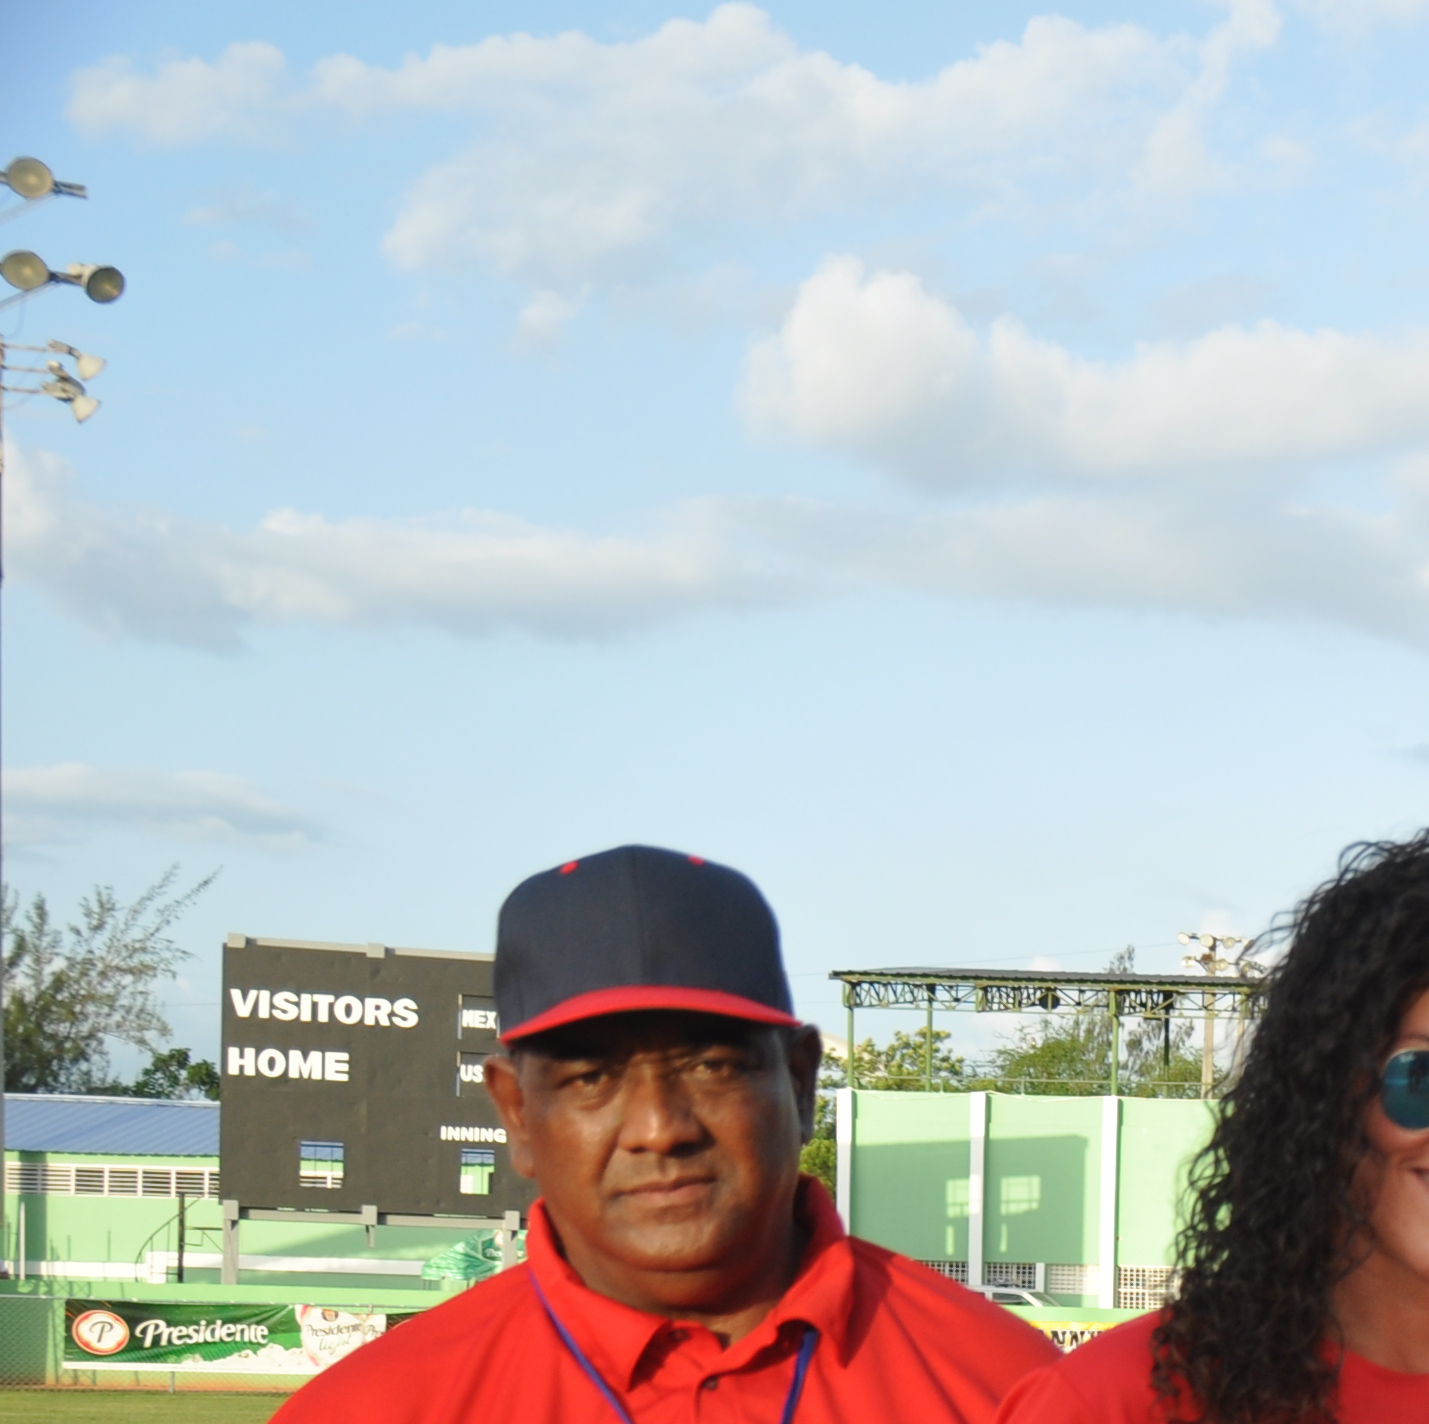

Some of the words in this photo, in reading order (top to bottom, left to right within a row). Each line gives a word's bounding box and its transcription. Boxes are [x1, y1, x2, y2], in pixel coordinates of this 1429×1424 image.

[229, 988, 419, 1028] VISITORS
[226, 1046, 350, 1082] HOME
[440, 1125, 507, 1143] INNING
[134, 1319, 270, 1348] Presidente
